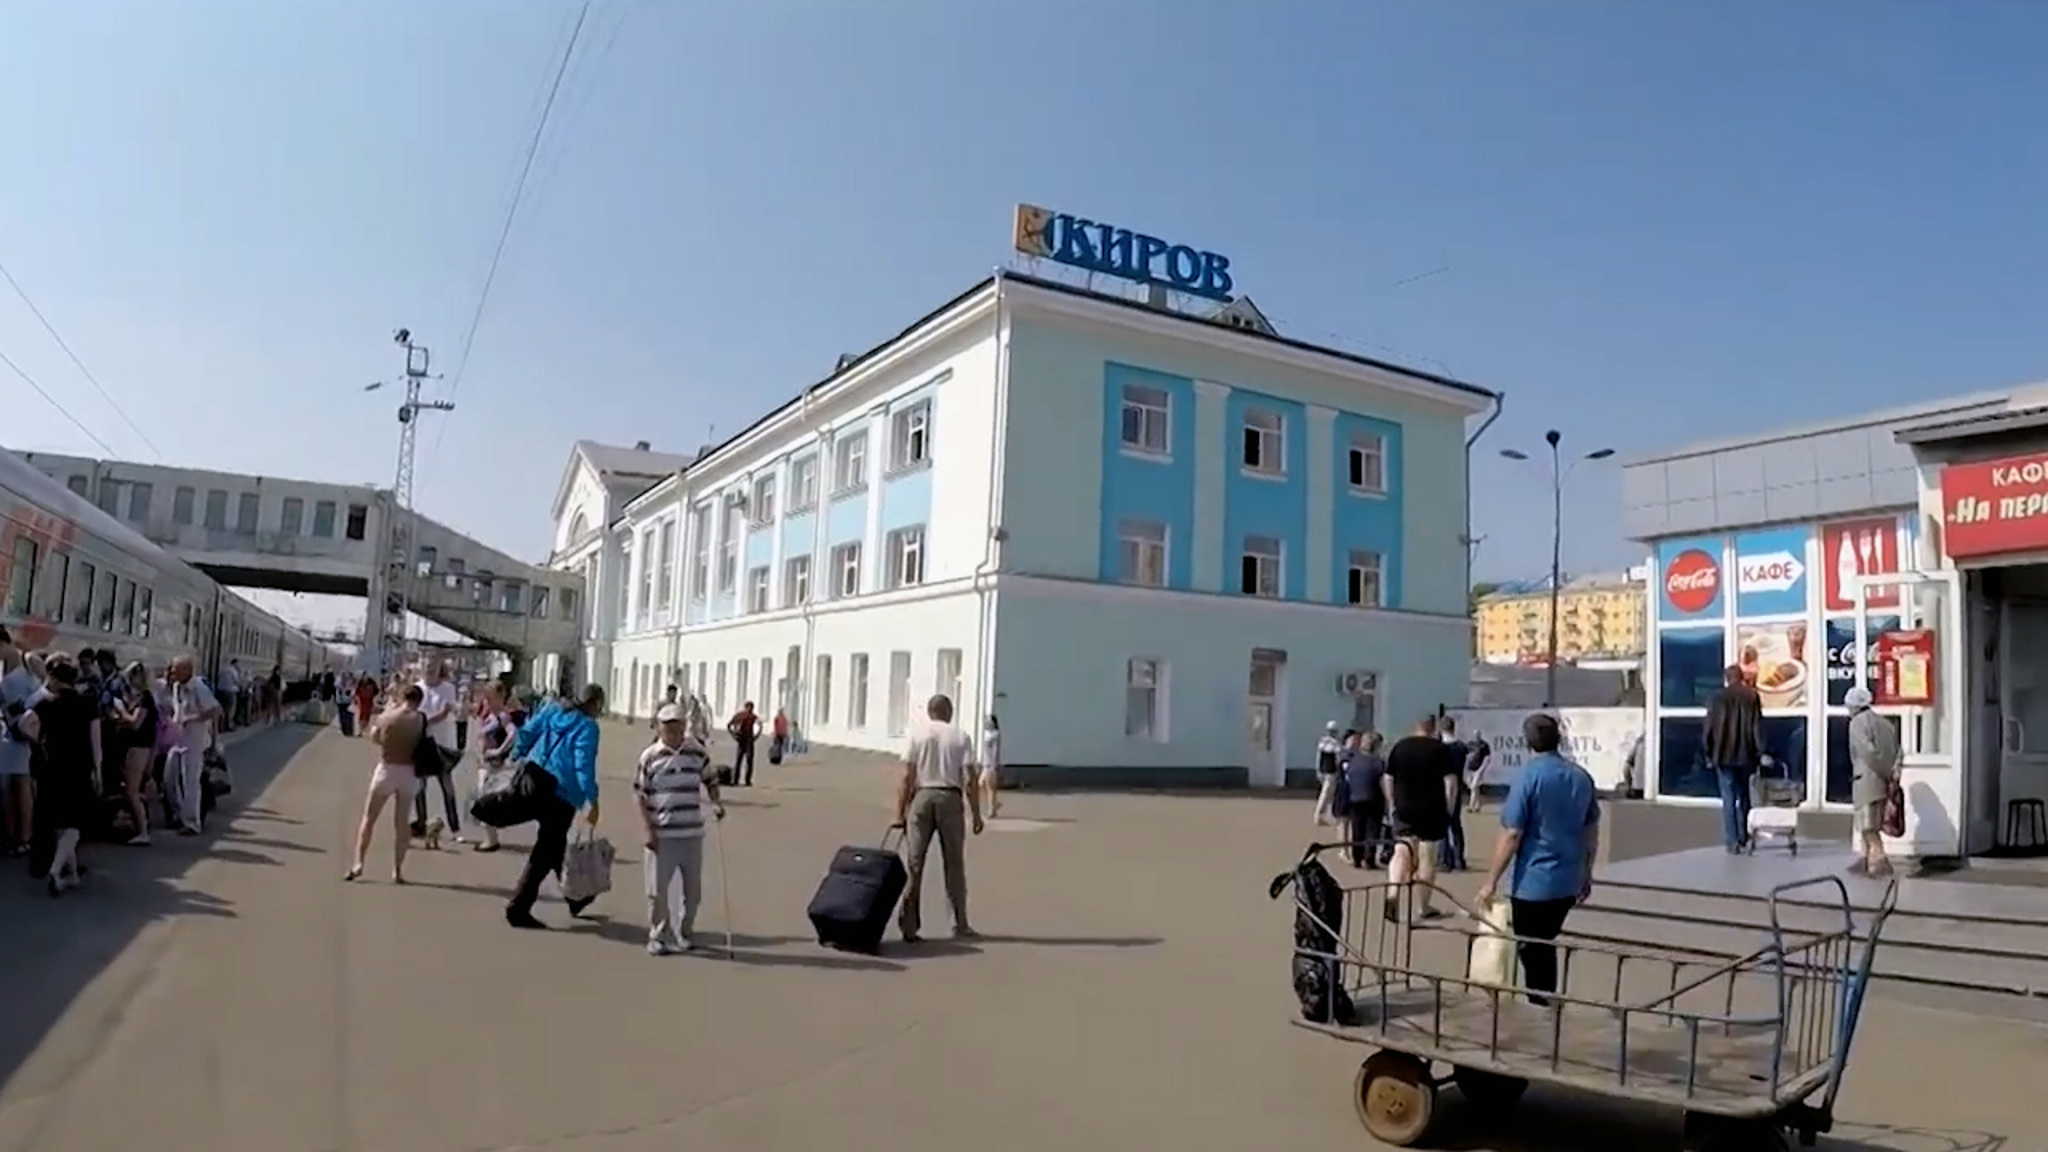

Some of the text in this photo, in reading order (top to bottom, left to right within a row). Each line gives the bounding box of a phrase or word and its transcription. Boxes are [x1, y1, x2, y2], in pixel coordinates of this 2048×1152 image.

[1053, 213, 1233, 300] КИРОВ
[1667, 567, 1717, 593] Coca-Cola
[1743, 561, 1794, 583] КАФЕ
